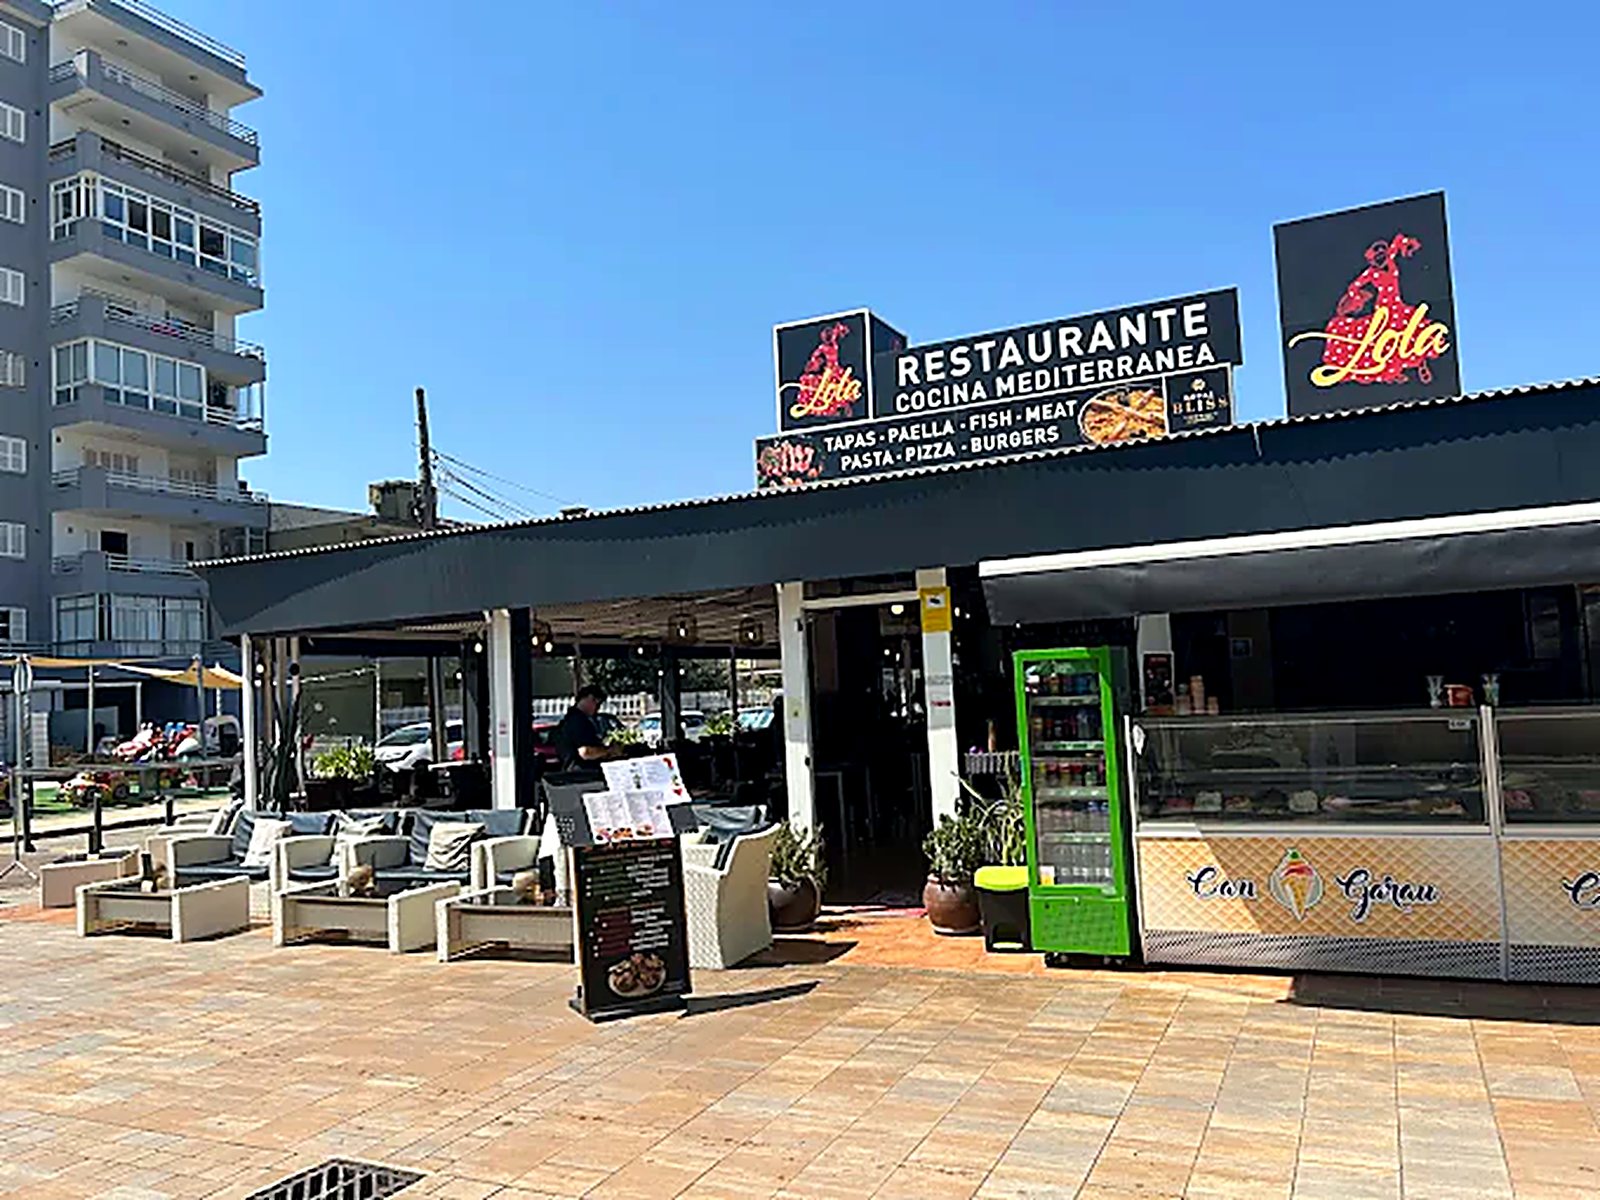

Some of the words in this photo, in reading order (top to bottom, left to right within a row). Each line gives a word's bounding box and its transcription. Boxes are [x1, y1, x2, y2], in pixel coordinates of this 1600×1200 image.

[897, 302, 1208, 387] RESTAURANTE
[1288, 302, 1450, 388] Lola
[779, 366, 862, 418] Lola
[895, 380, 987, 413] COCINA
[995, 342, 1215, 398] MEDITERRANEA
[823, 430, 876, 452] TAPAS
[887, 419, 955, 443] PAELLA
[969, 409, 1012, 431] FISH
[1025, 400, 1077, 423] MEAT
[841, 449, 894, 471] PASTA
[905, 441, 955, 462] PIZZA
[970, 425, 1059, 453] BURGERS
[1187, 866, 1255, 897] Can
